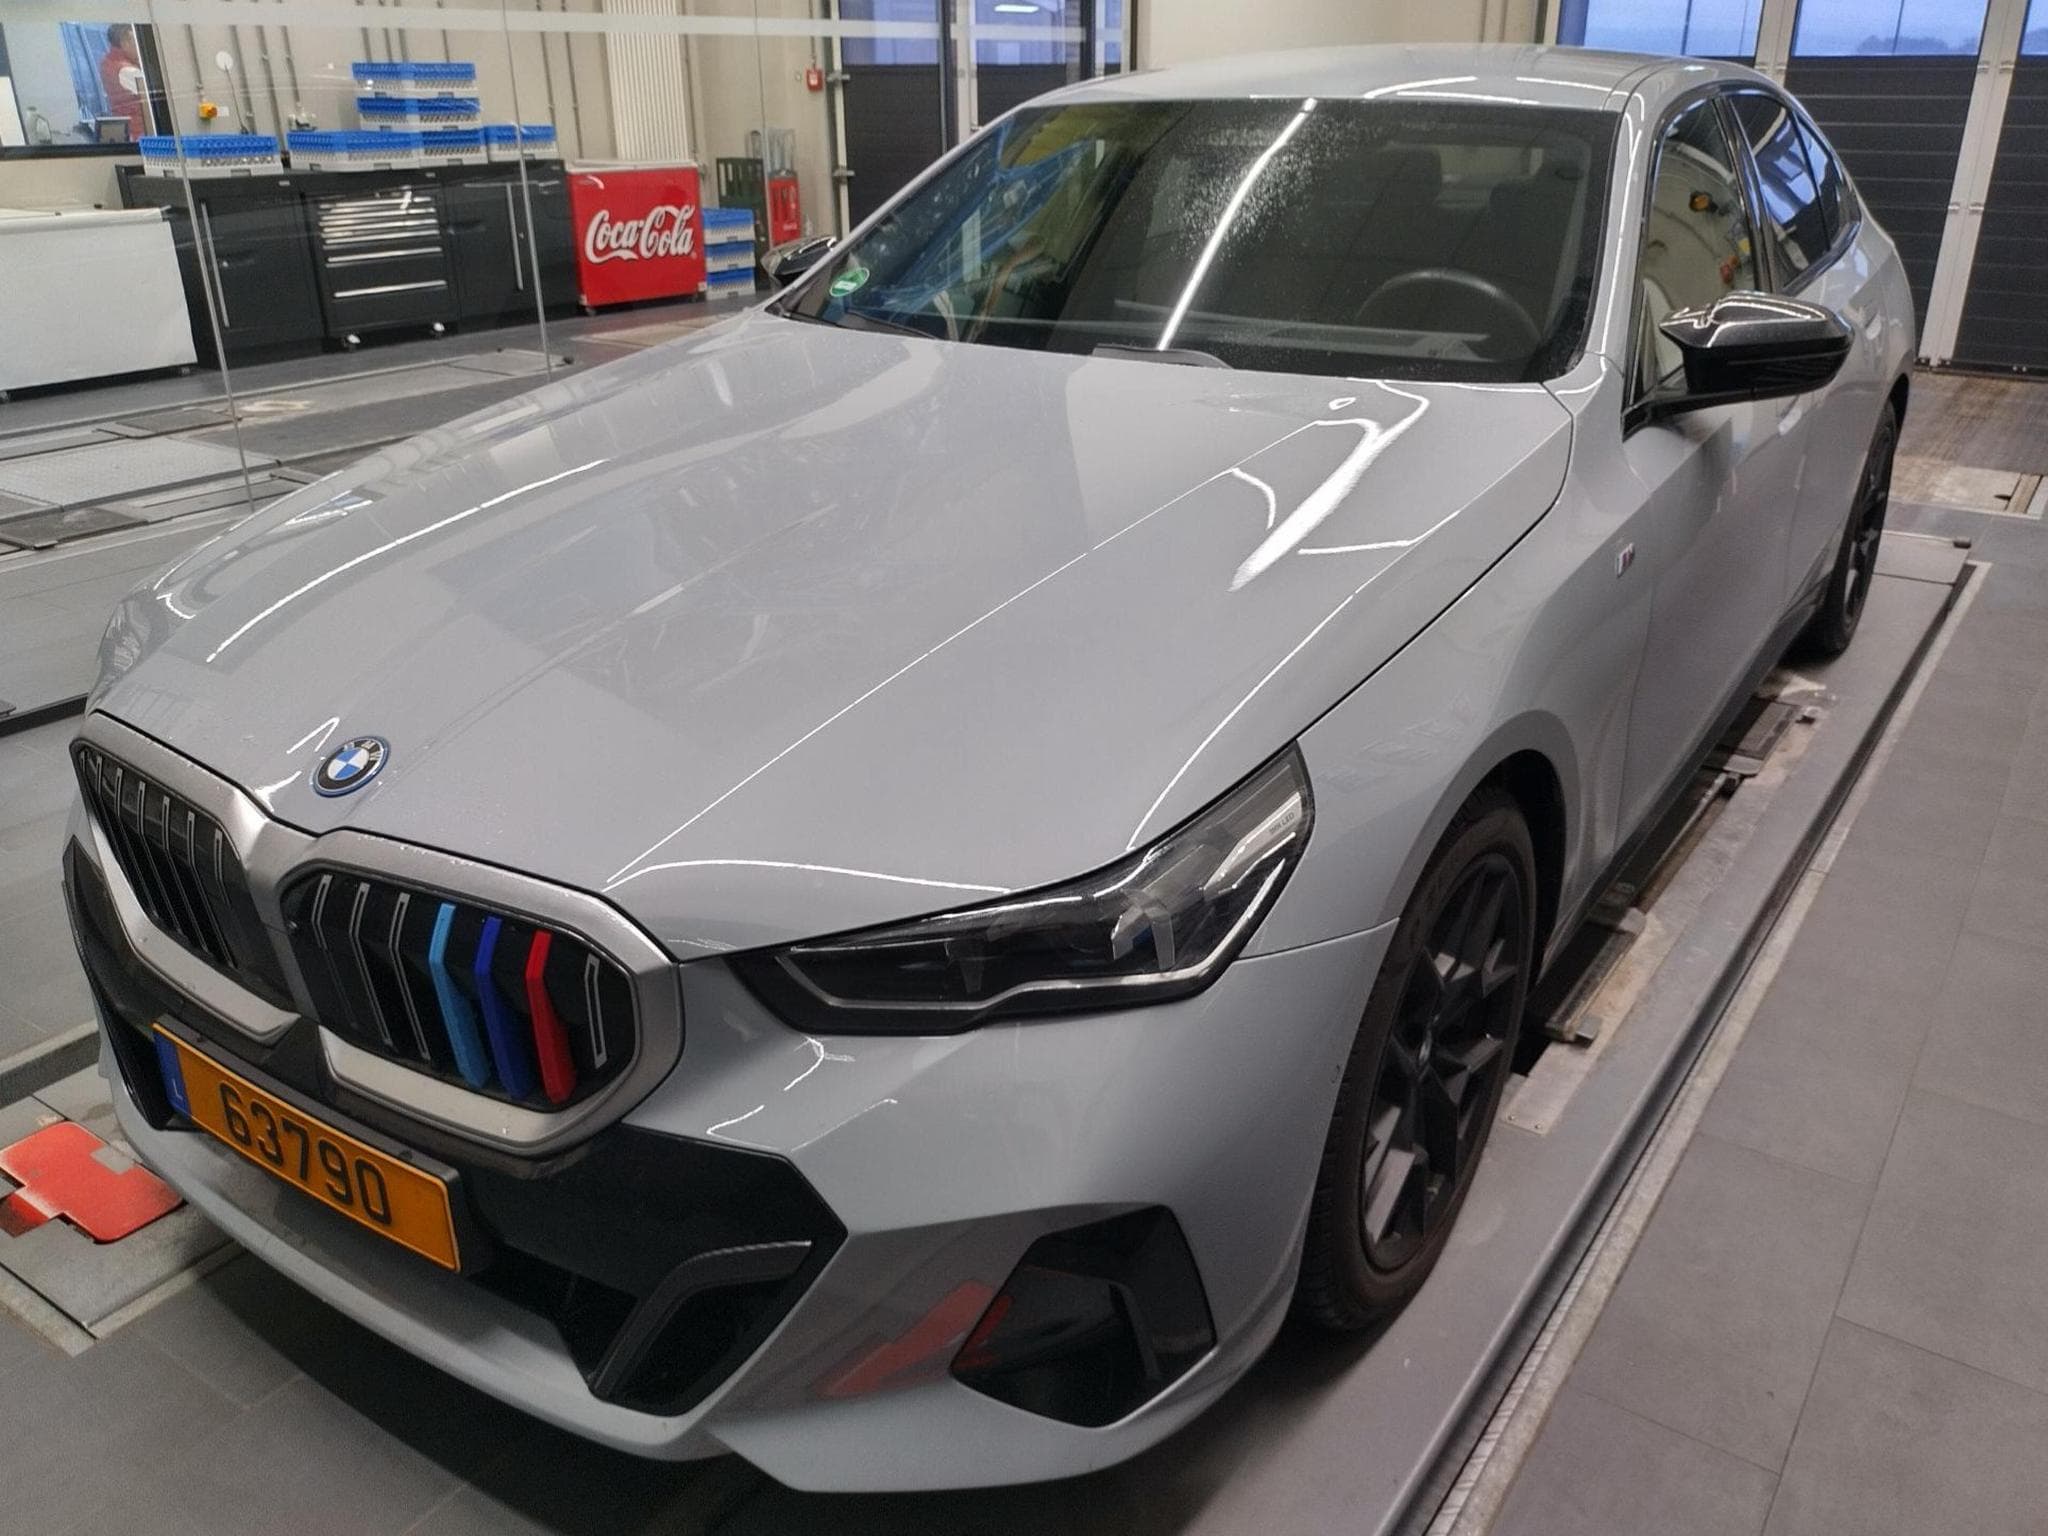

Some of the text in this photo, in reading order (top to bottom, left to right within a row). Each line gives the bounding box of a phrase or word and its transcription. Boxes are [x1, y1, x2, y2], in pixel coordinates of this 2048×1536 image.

[585, 204, 696, 264] Coca-Cola
[172, 1078, 185, 1101] L
[219, 1080, 393, 1225] 63790
